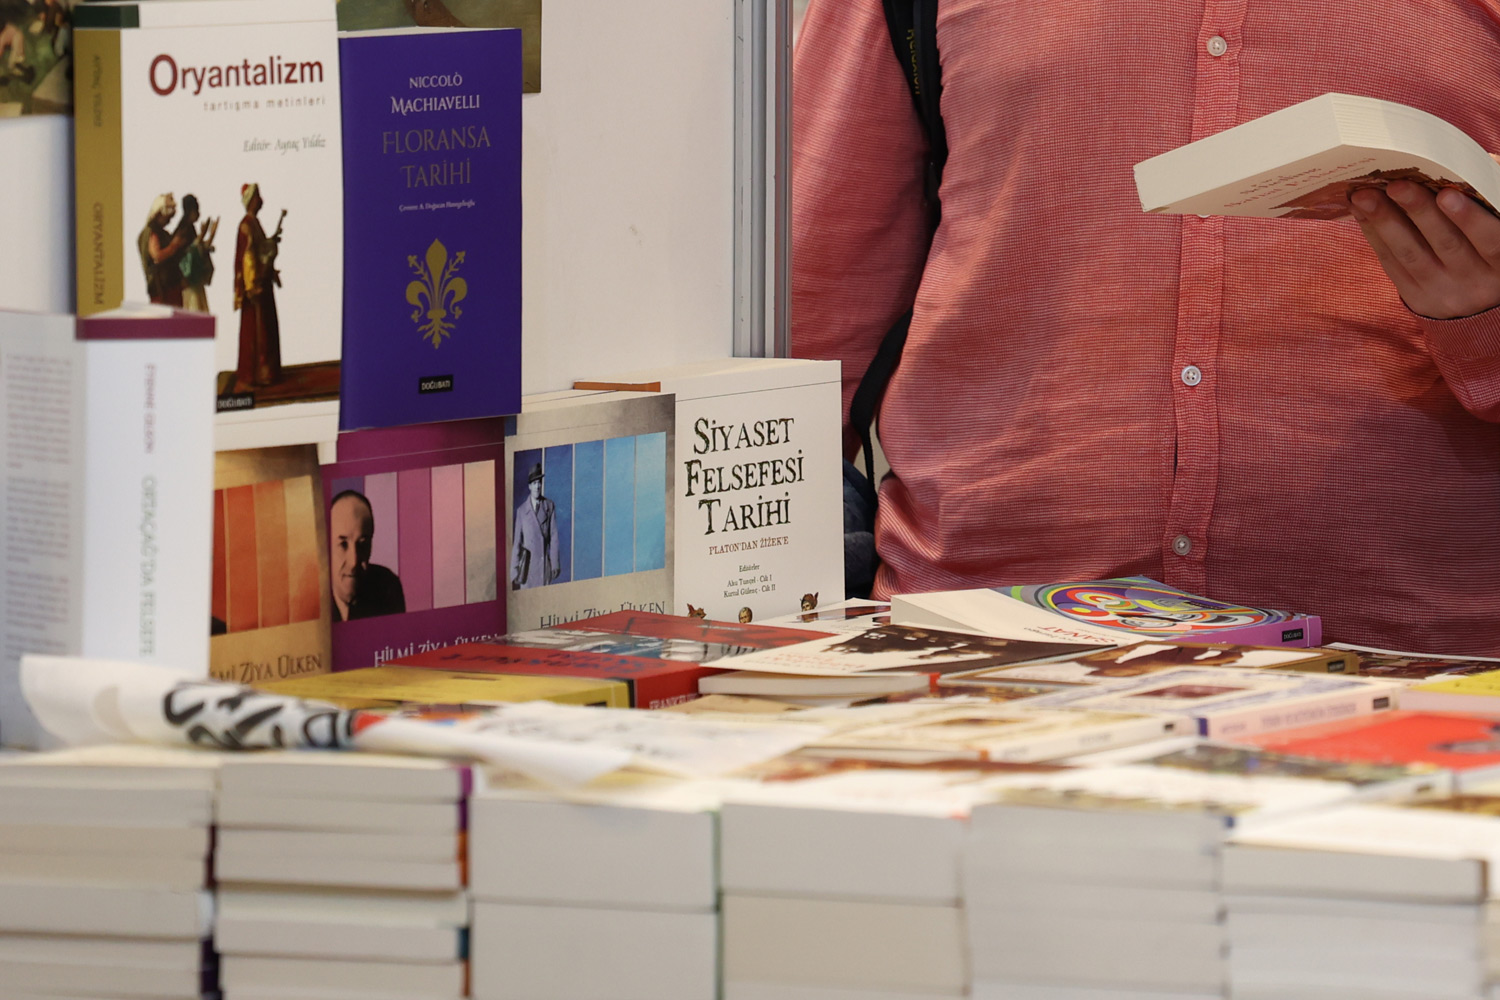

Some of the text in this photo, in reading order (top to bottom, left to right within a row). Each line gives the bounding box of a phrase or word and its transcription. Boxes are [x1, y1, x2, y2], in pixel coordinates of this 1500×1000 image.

[149, 53, 324, 97] Oryantalizm
[409, 72, 463, 89] NICCOLÒ
[265, 96, 326, 108] metinleri
[390, 94, 481, 117] MACHIAVELLI
[382, 125, 492, 155] FLORANSA
[400, 157, 472, 189] TARİHİ
[693, 416, 795, 455] SİYASET
[684, 449, 805, 497] FELSEFESİ
[698, 491, 791, 536] TARİHİ
[708, 539, 758, 556] PLATON'DAN
